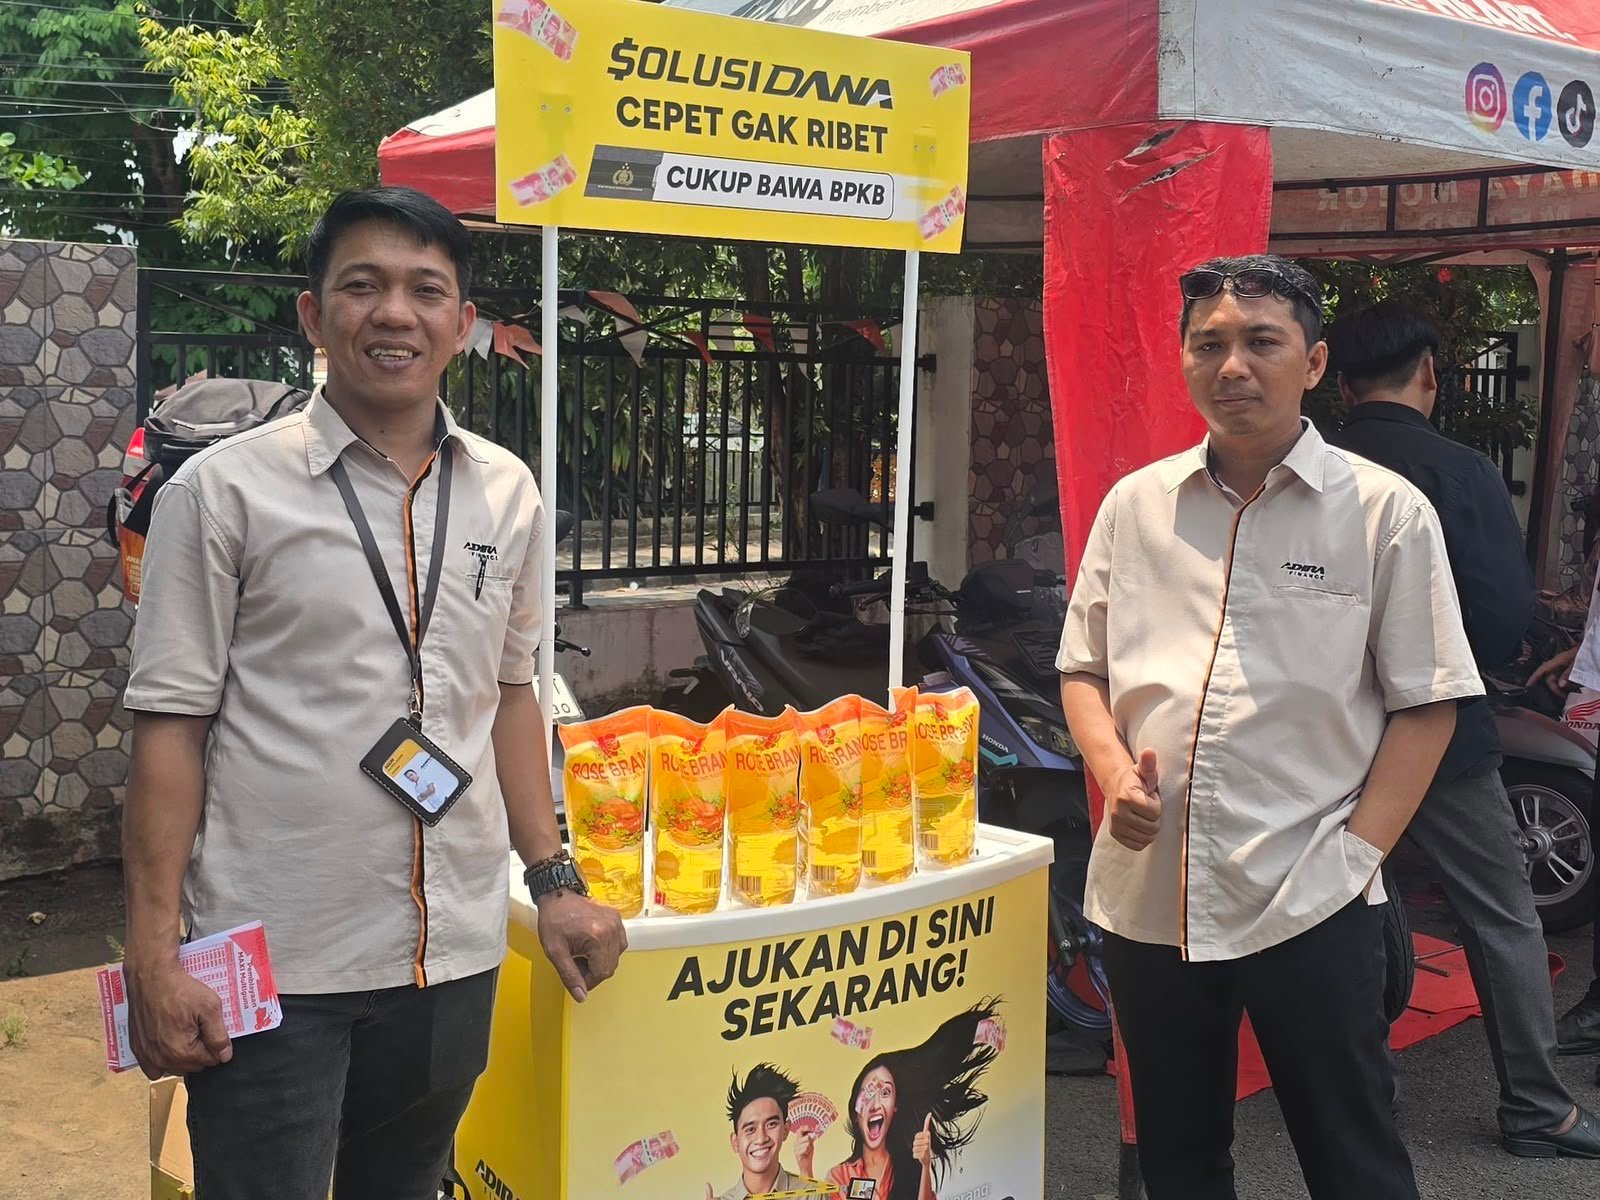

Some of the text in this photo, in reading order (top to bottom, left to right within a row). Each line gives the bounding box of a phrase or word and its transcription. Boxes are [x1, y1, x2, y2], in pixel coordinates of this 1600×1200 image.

[616, 96, 888, 154] CEPET GAK RIBET
[666, 166, 885, 205] CUKUP BAWA BPKB
[463, 541, 497, 554] ADIRA
[1281, 562, 1325, 574] ADIRA
[1289, 571, 1325, 580] FINANCE
[1565, 720, 1600, 730] ONDA
[982, 734, 1008, 753] HONDA
[572, 762, 608, 779] ROSE
[667, 896, 994, 1001] AJUKAN DI SINI
[238, 951, 246, 971] MAXI
[721, 948, 968, 1041] SEKARANG!
[475, 1159, 520, 1200] ADIR
